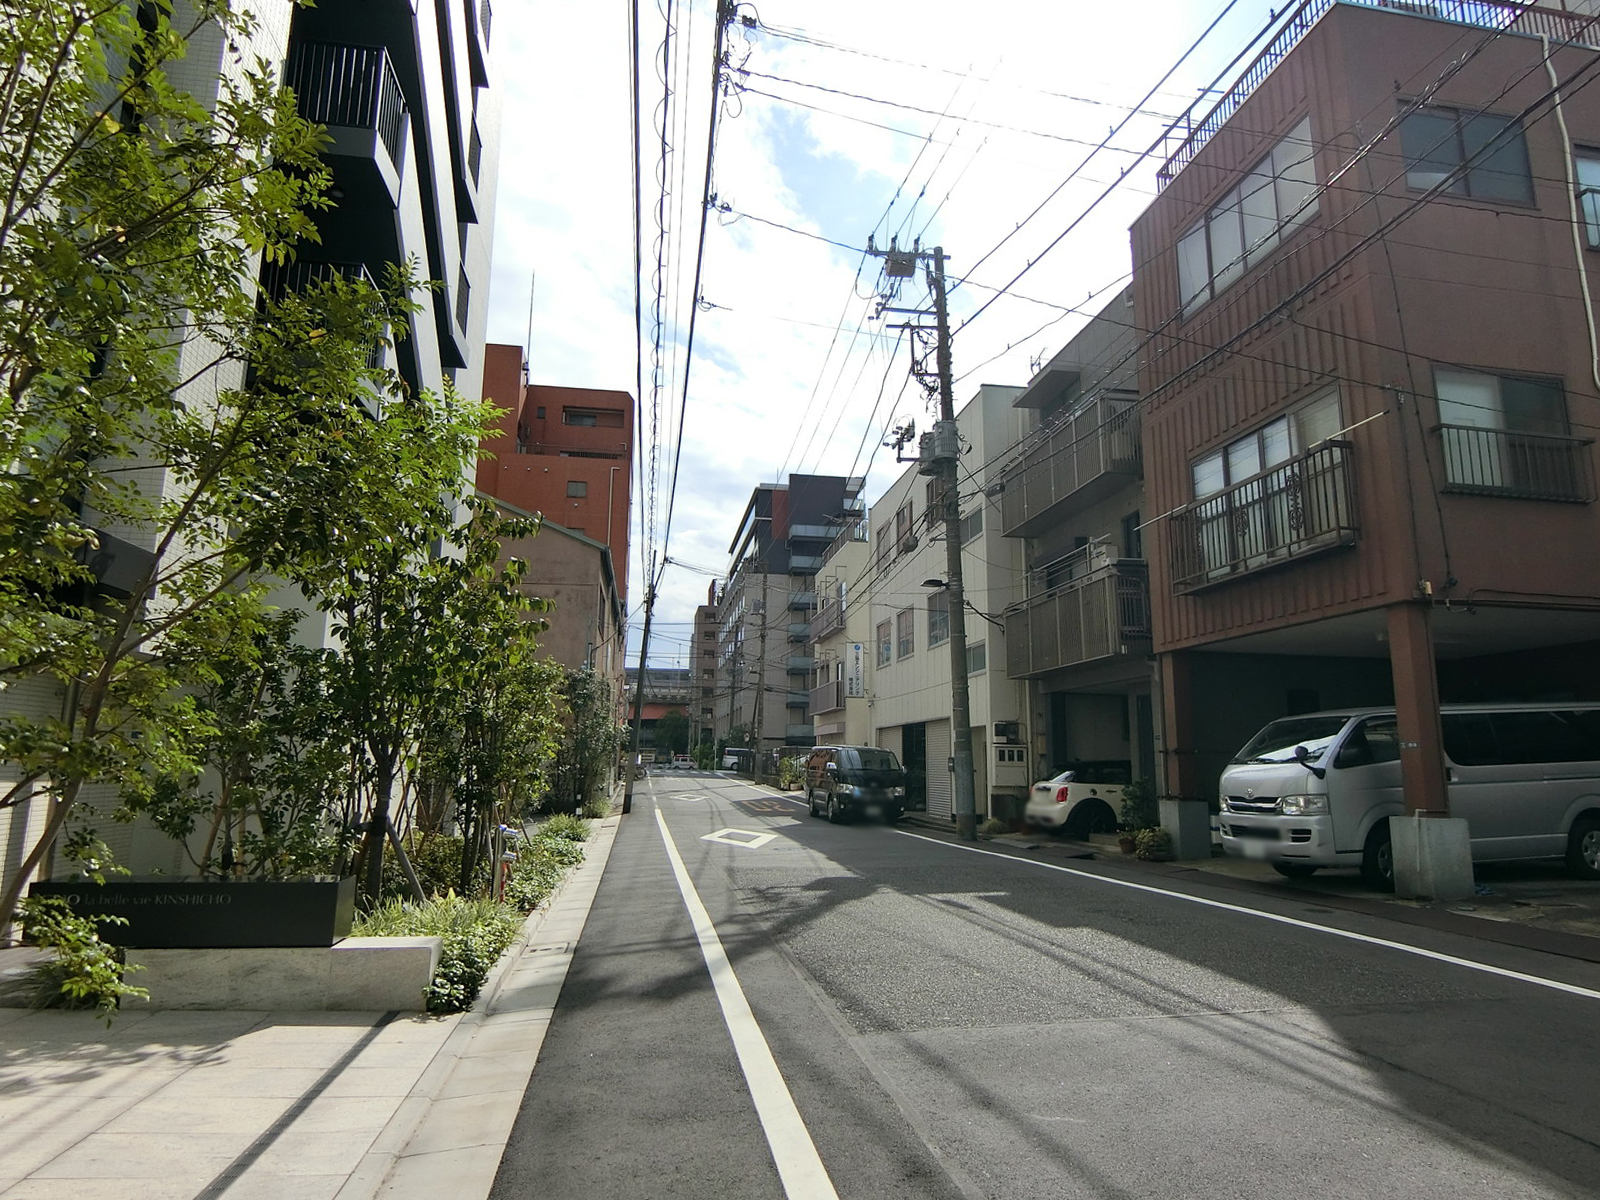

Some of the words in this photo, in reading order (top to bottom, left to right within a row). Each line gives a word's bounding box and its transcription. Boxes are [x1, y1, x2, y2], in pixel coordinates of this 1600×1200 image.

[99, 894, 129, 905] belle
[133, 894, 151, 905] vie
[154, 894, 232, 905] KINSHICHO
